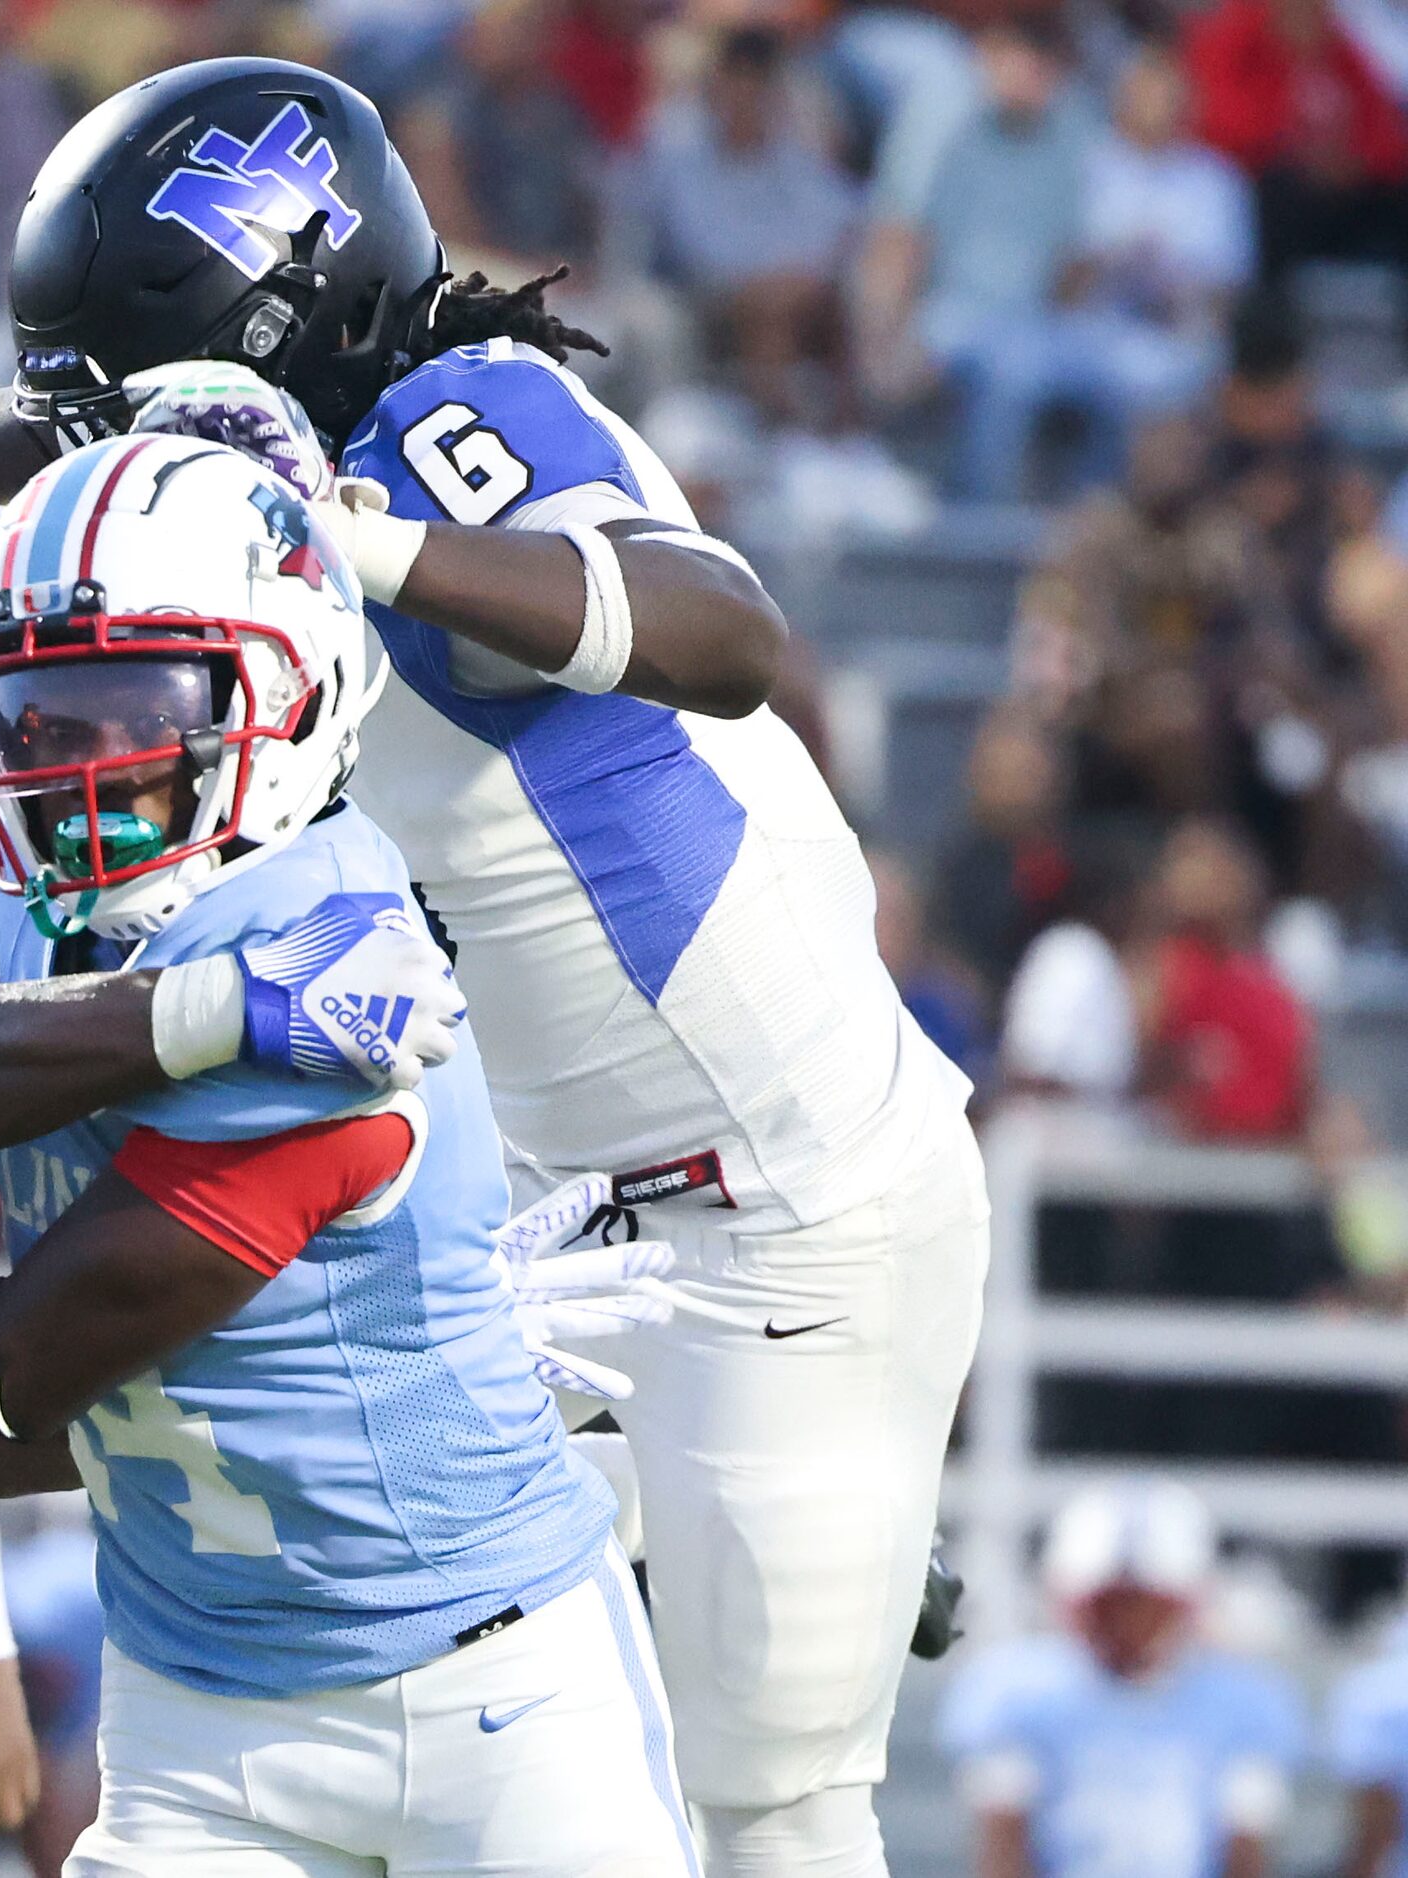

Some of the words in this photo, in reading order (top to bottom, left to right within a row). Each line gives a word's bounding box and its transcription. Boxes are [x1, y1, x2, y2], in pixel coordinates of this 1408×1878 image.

[146, 100, 362, 281] NF
[399, 400, 535, 526] 6
[320, 996, 396, 1074] adidas
[620, 1169, 690, 1199] SIEGE
